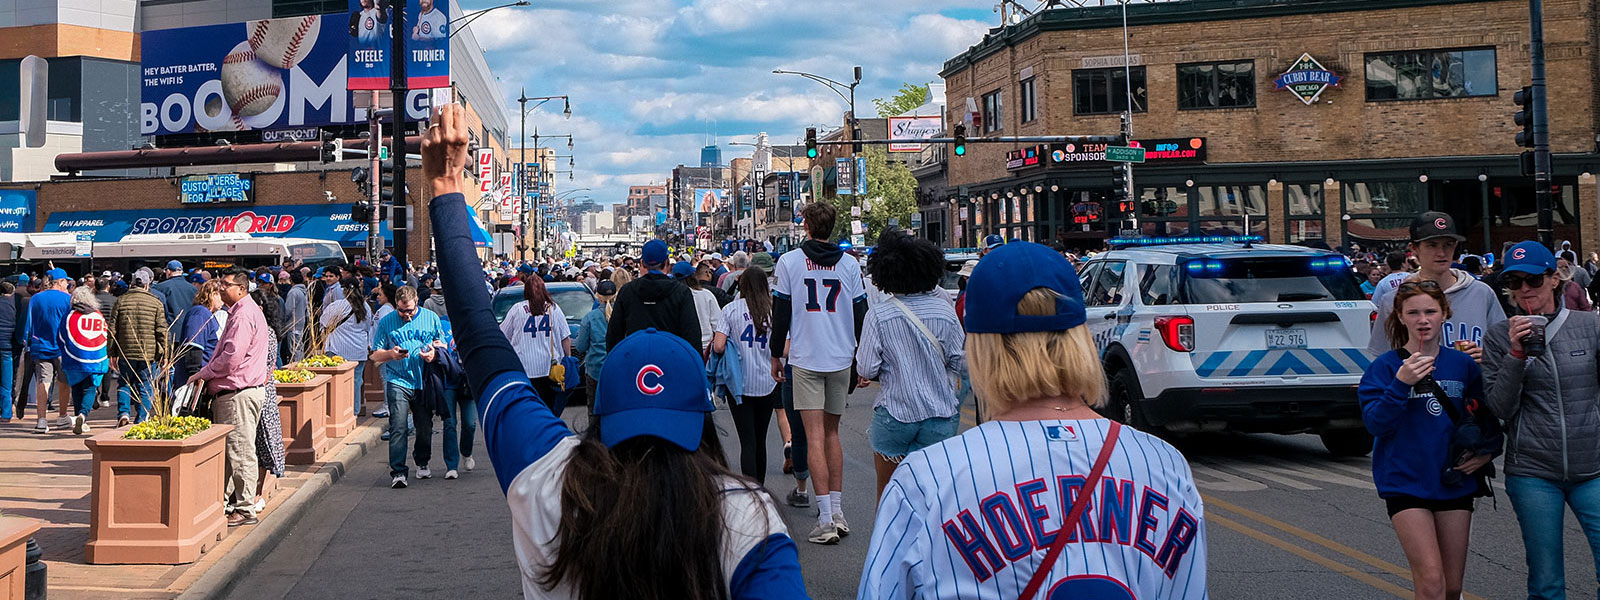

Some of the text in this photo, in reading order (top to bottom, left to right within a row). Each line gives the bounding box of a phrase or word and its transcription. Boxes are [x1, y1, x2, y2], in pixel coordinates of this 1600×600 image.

[355, 50, 383, 62] STEELE
[412, 50, 445, 62] TURNER
[1111, 56, 1137, 65] LOUAS
[144, 62, 217, 75] HEY BATTER BATTER,
[176, 76, 183, 84] IS
[1283, 72, 1330, 84] CUBBY BEAR
[893, 121, 940, 137] Sluggers
[1083, 144, 1107, 152] TEAM
[480, 153, 492, 192] UFC
[182, 175, 250, 191] CUSTOM JERSEYS
[756, 171, 764, 200] HVAC
[188, 193, 203, 203] FOR
[221, 187, 243, 201] AGES
[75, 219, 104, 227] APPAREL
[334, 224, 370, 232] JERSEYS
[804, 279, 842, 312] 17
[524, 314, 552, 338] 44
[741, 324, 768, 350] 44
[1275, 335, 1284, 345] 22
[1289, 335, 1304, 345] 976
[636, 364, 664, 396] C
[942, 475, 1199, 583] HOERNER
